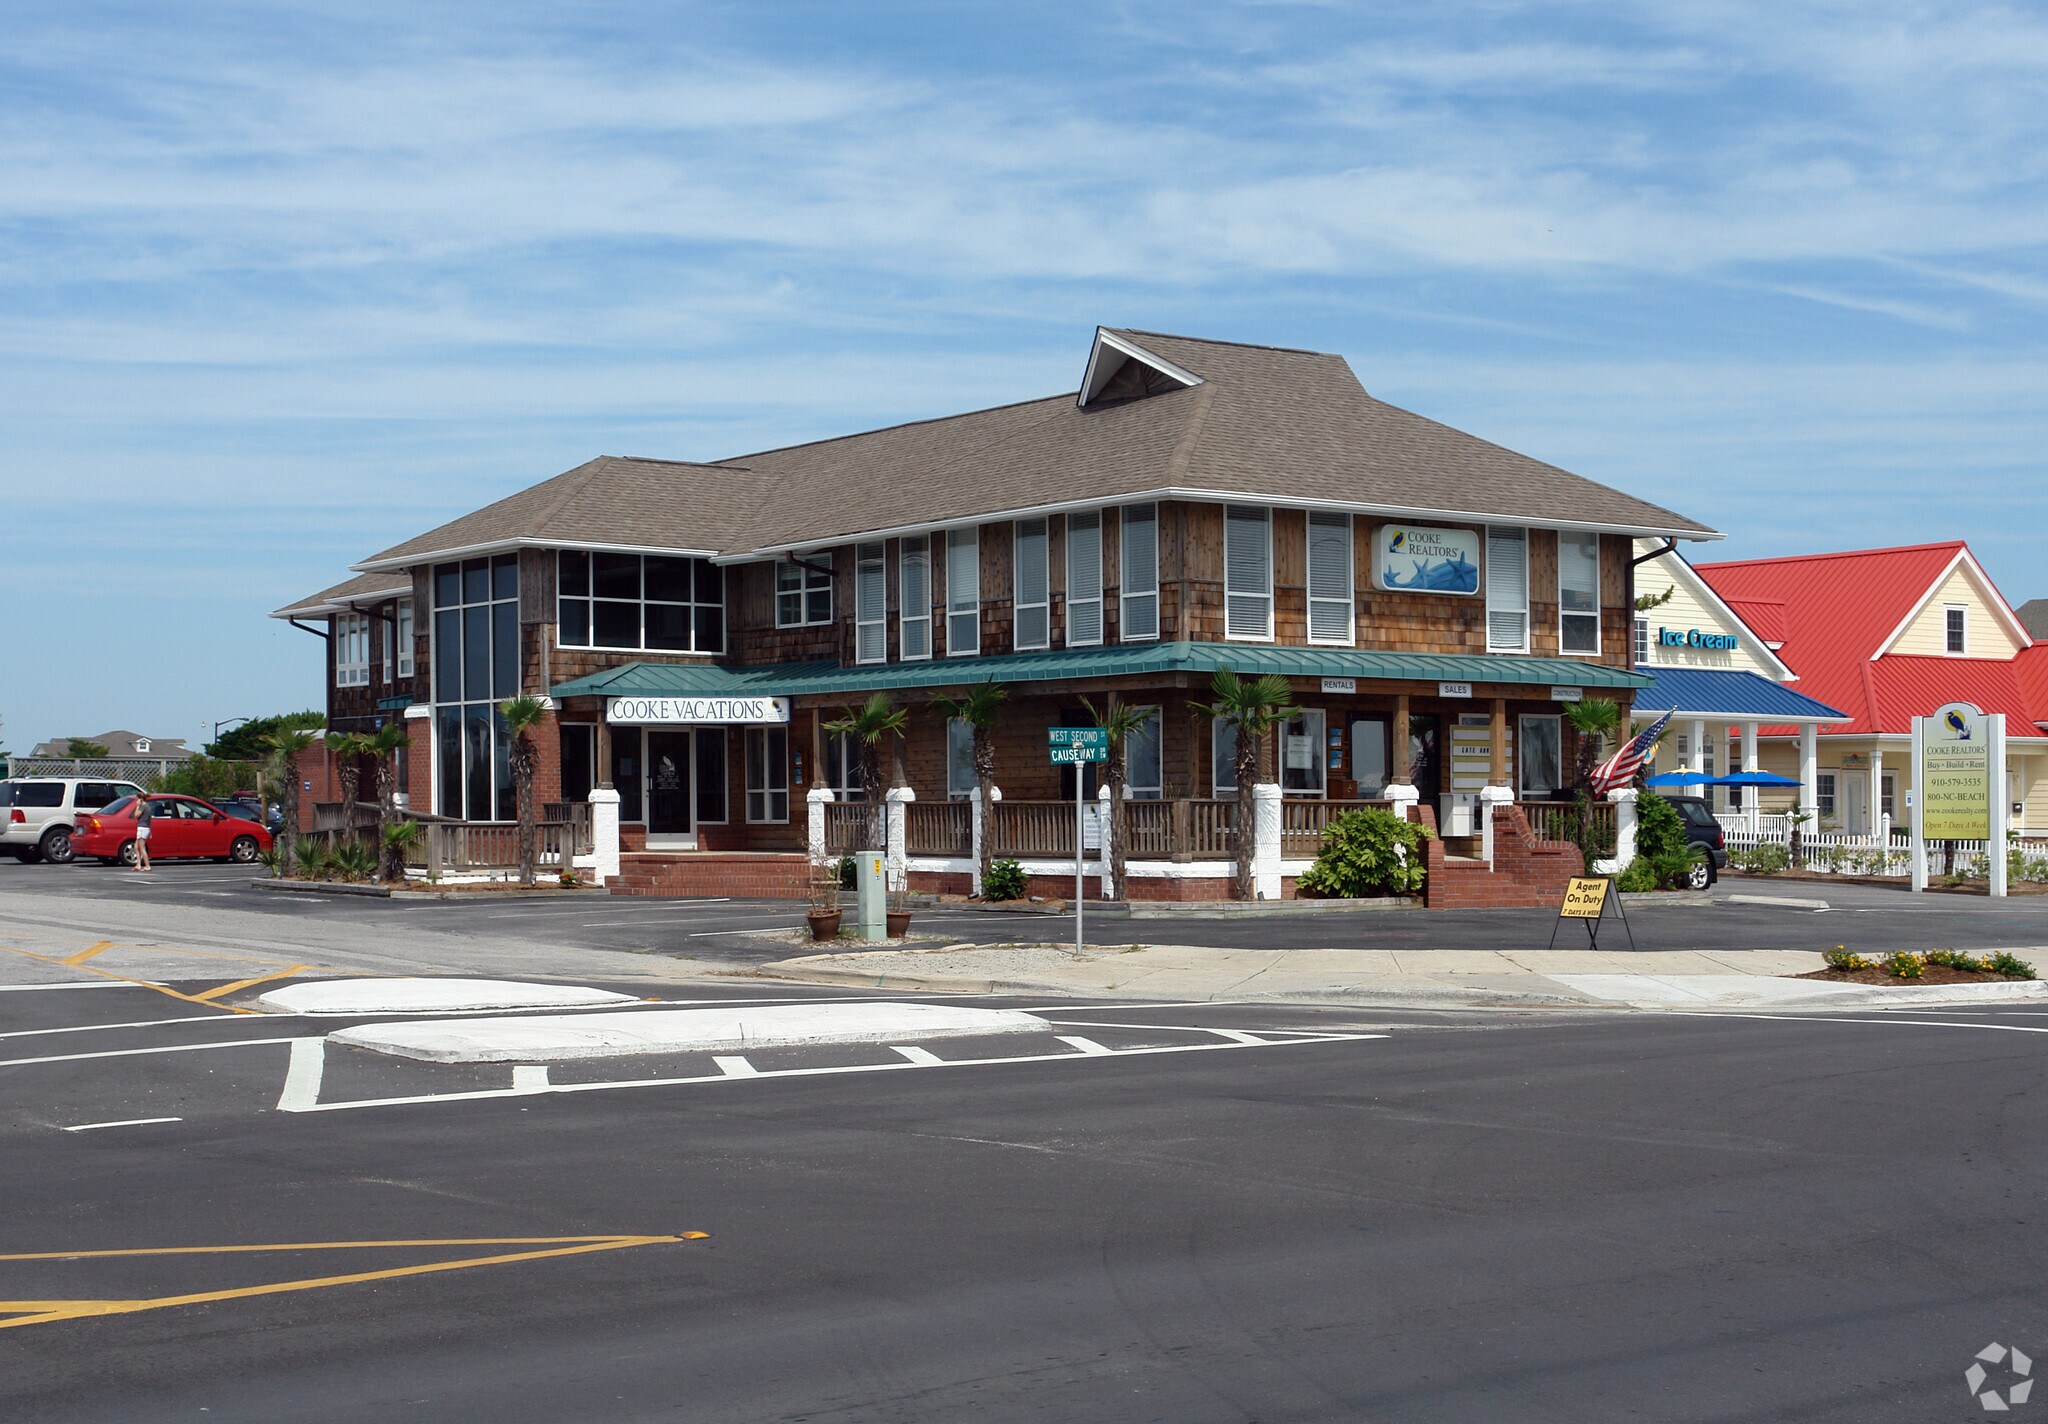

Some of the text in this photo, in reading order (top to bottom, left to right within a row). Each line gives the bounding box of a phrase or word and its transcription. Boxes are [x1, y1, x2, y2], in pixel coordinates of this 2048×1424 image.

[1408, 531, 1441, 544] COOKE
[1409, 543, 1457, 557] REALTORS
[1659, 626, 1738, 650] Ice Cream
[1324, 681, 1354, 689] RENTALS
[1444, 685, 1467, 694] SALES
[613, 700, 764, 719] COOKE VACATIONS
[1049, 730, 1068, 742] WEST
[1071, 731, 1098, 742] SECOND
[1051, 748, 1096, 762] CAUSEWAY
[1926, 745, 1986, 755] COOKE REALTORS
[1927, 760, 1985, 770] Buy Build Rent
[1931, 777, 1982, 787] 910-579-3535
[1927, 792, 1985, 801] 800-NC-BEACH
[1926, 806, 1987, 816] www.cookerealty.com
[1925, 821, 1942, 831] Open
[1943, 821, 1948, 829] 7
[1949, 821, 1964, 830] Days
[1971, 821, 1987, 829] Week
[1576, 882, 1601, 892] Agent
[1567, 894, 1603, 906] On Duty
